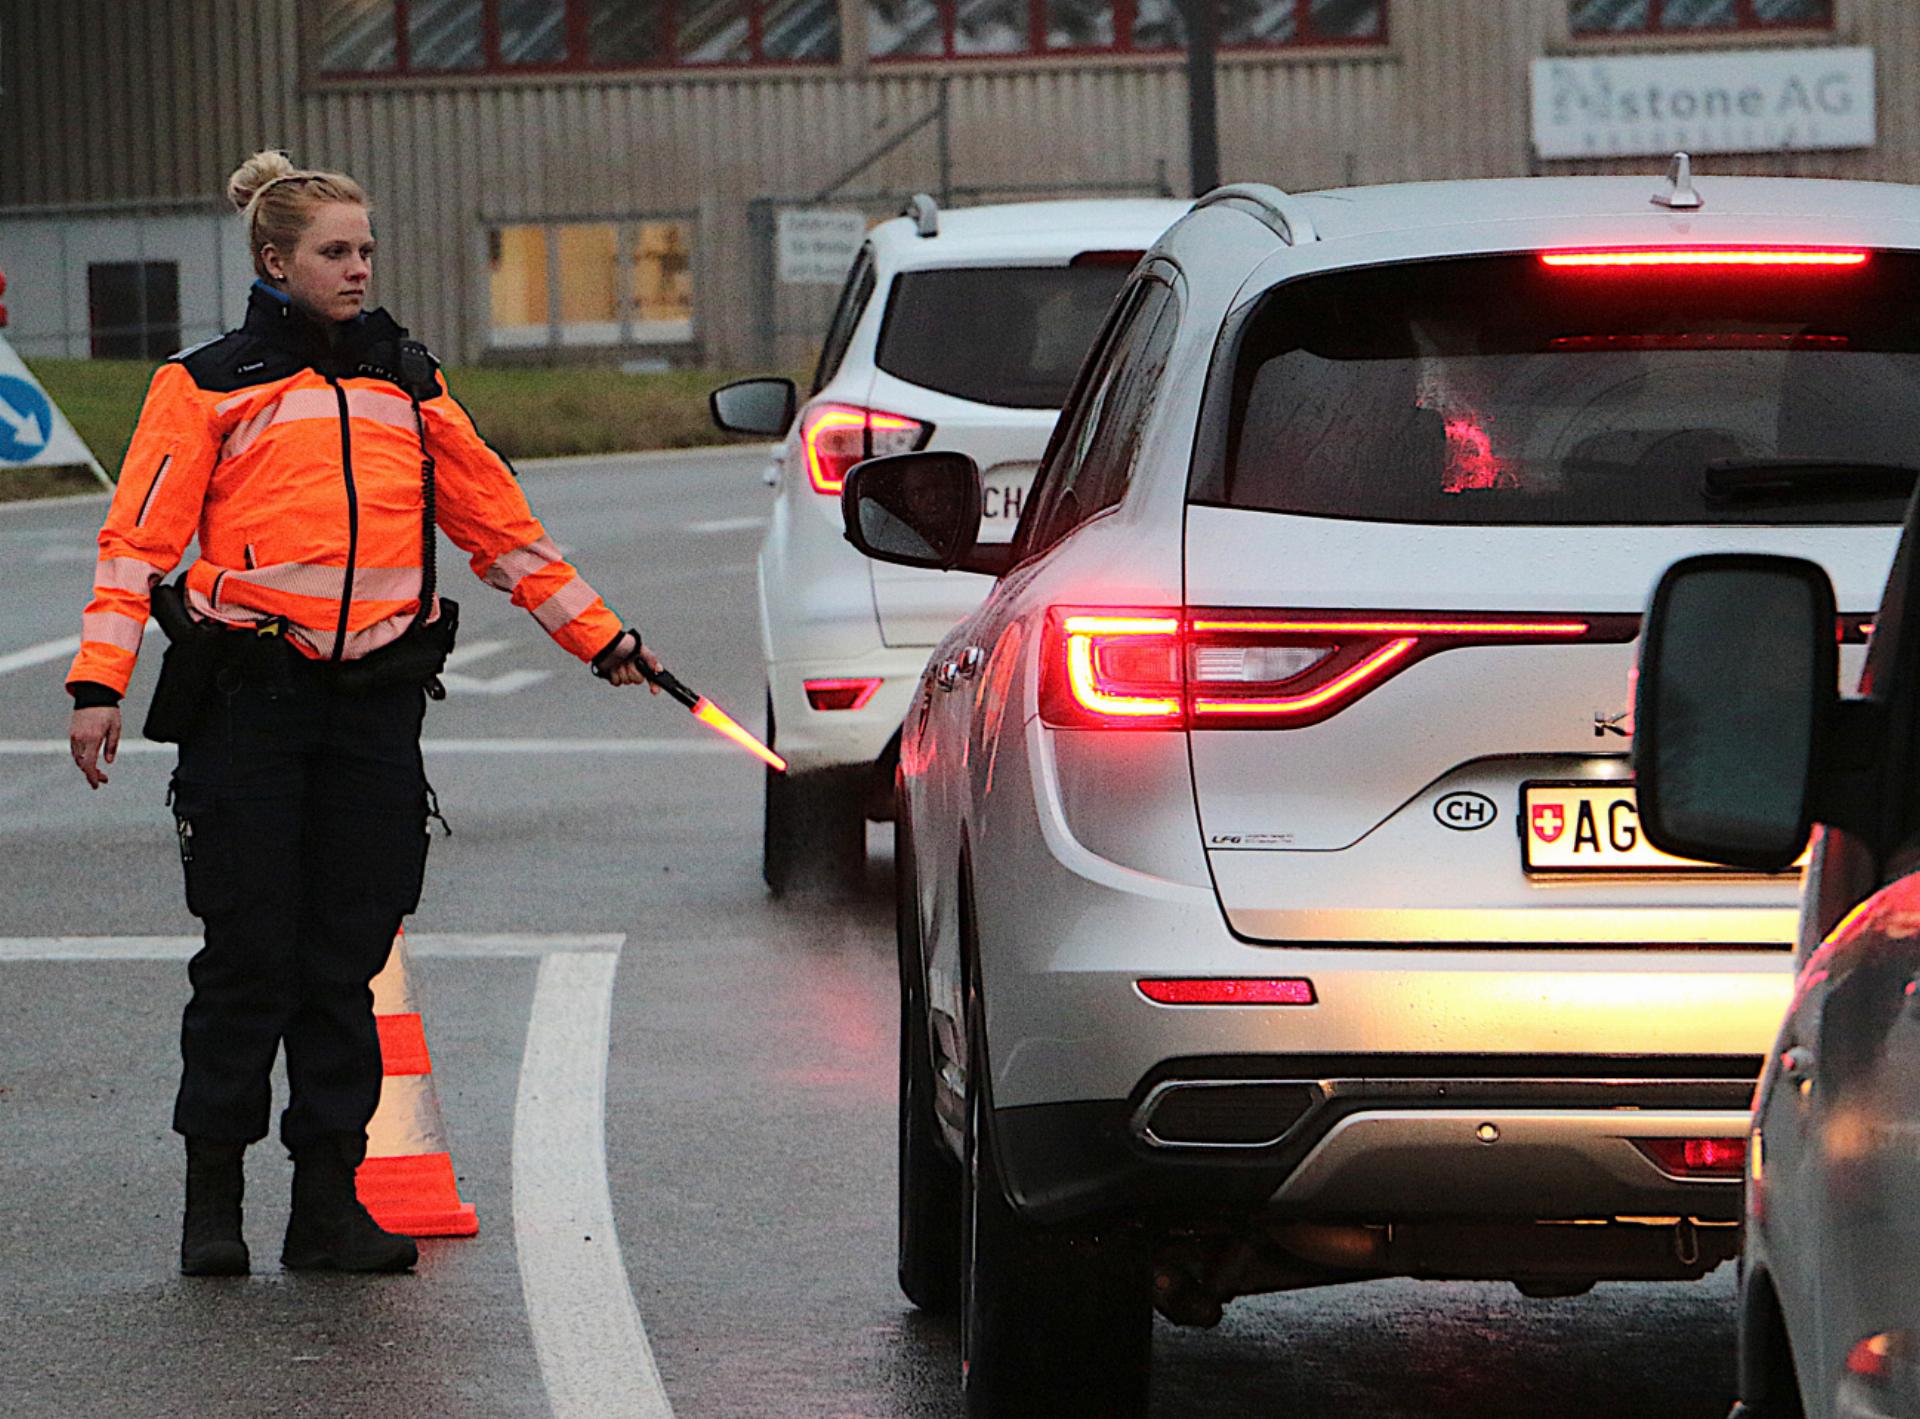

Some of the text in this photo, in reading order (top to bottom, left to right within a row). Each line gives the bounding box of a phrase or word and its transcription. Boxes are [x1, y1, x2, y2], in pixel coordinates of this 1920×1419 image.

[1776, 70, 1854, 117] AG
[983, 486, 1022, 519] CH
[1446, 800, 1485, 822] CH
[1572, 799, 1638, 853] AG
